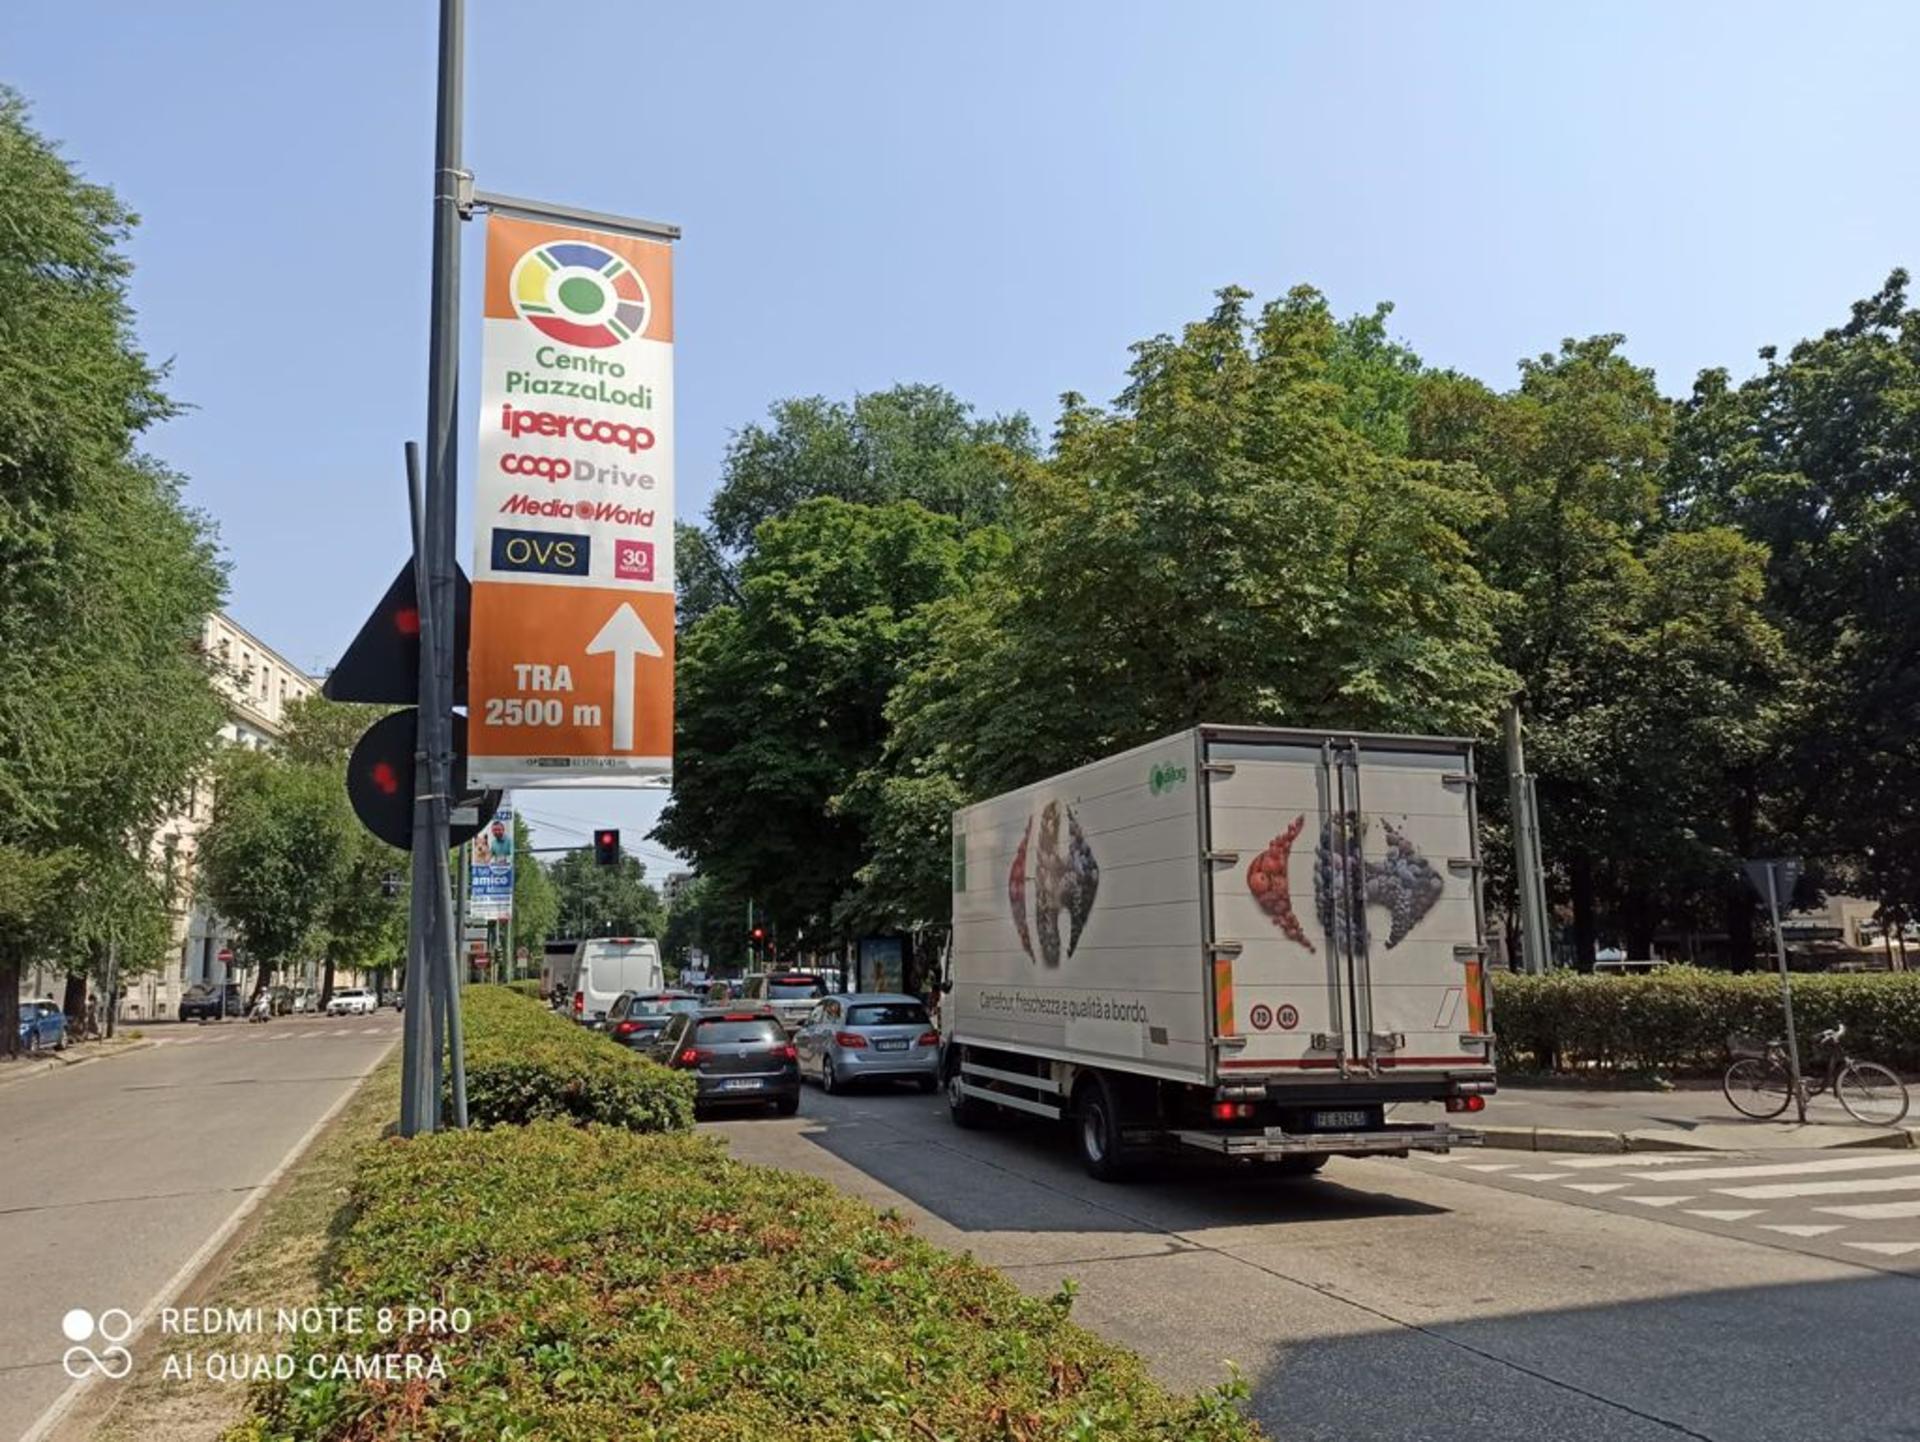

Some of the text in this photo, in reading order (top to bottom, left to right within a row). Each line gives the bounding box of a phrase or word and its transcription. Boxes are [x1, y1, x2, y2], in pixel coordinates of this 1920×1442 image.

[536, 346, 625, 378] Centro
[506, 371, 652, 409] PiazzaLodi
[502, 403, 655, 453] ipercoop
[499, 494, 655, 527] Media World
[506, 538, 576, 567] OVS
[622, 549, 647, 566] 30
[513, 664, 574, 691] TRA
[485, 698, 601, 727] 2500 m
[472, 876, 508, 888] amico
[1104, 1002, 1111, 1020] a
